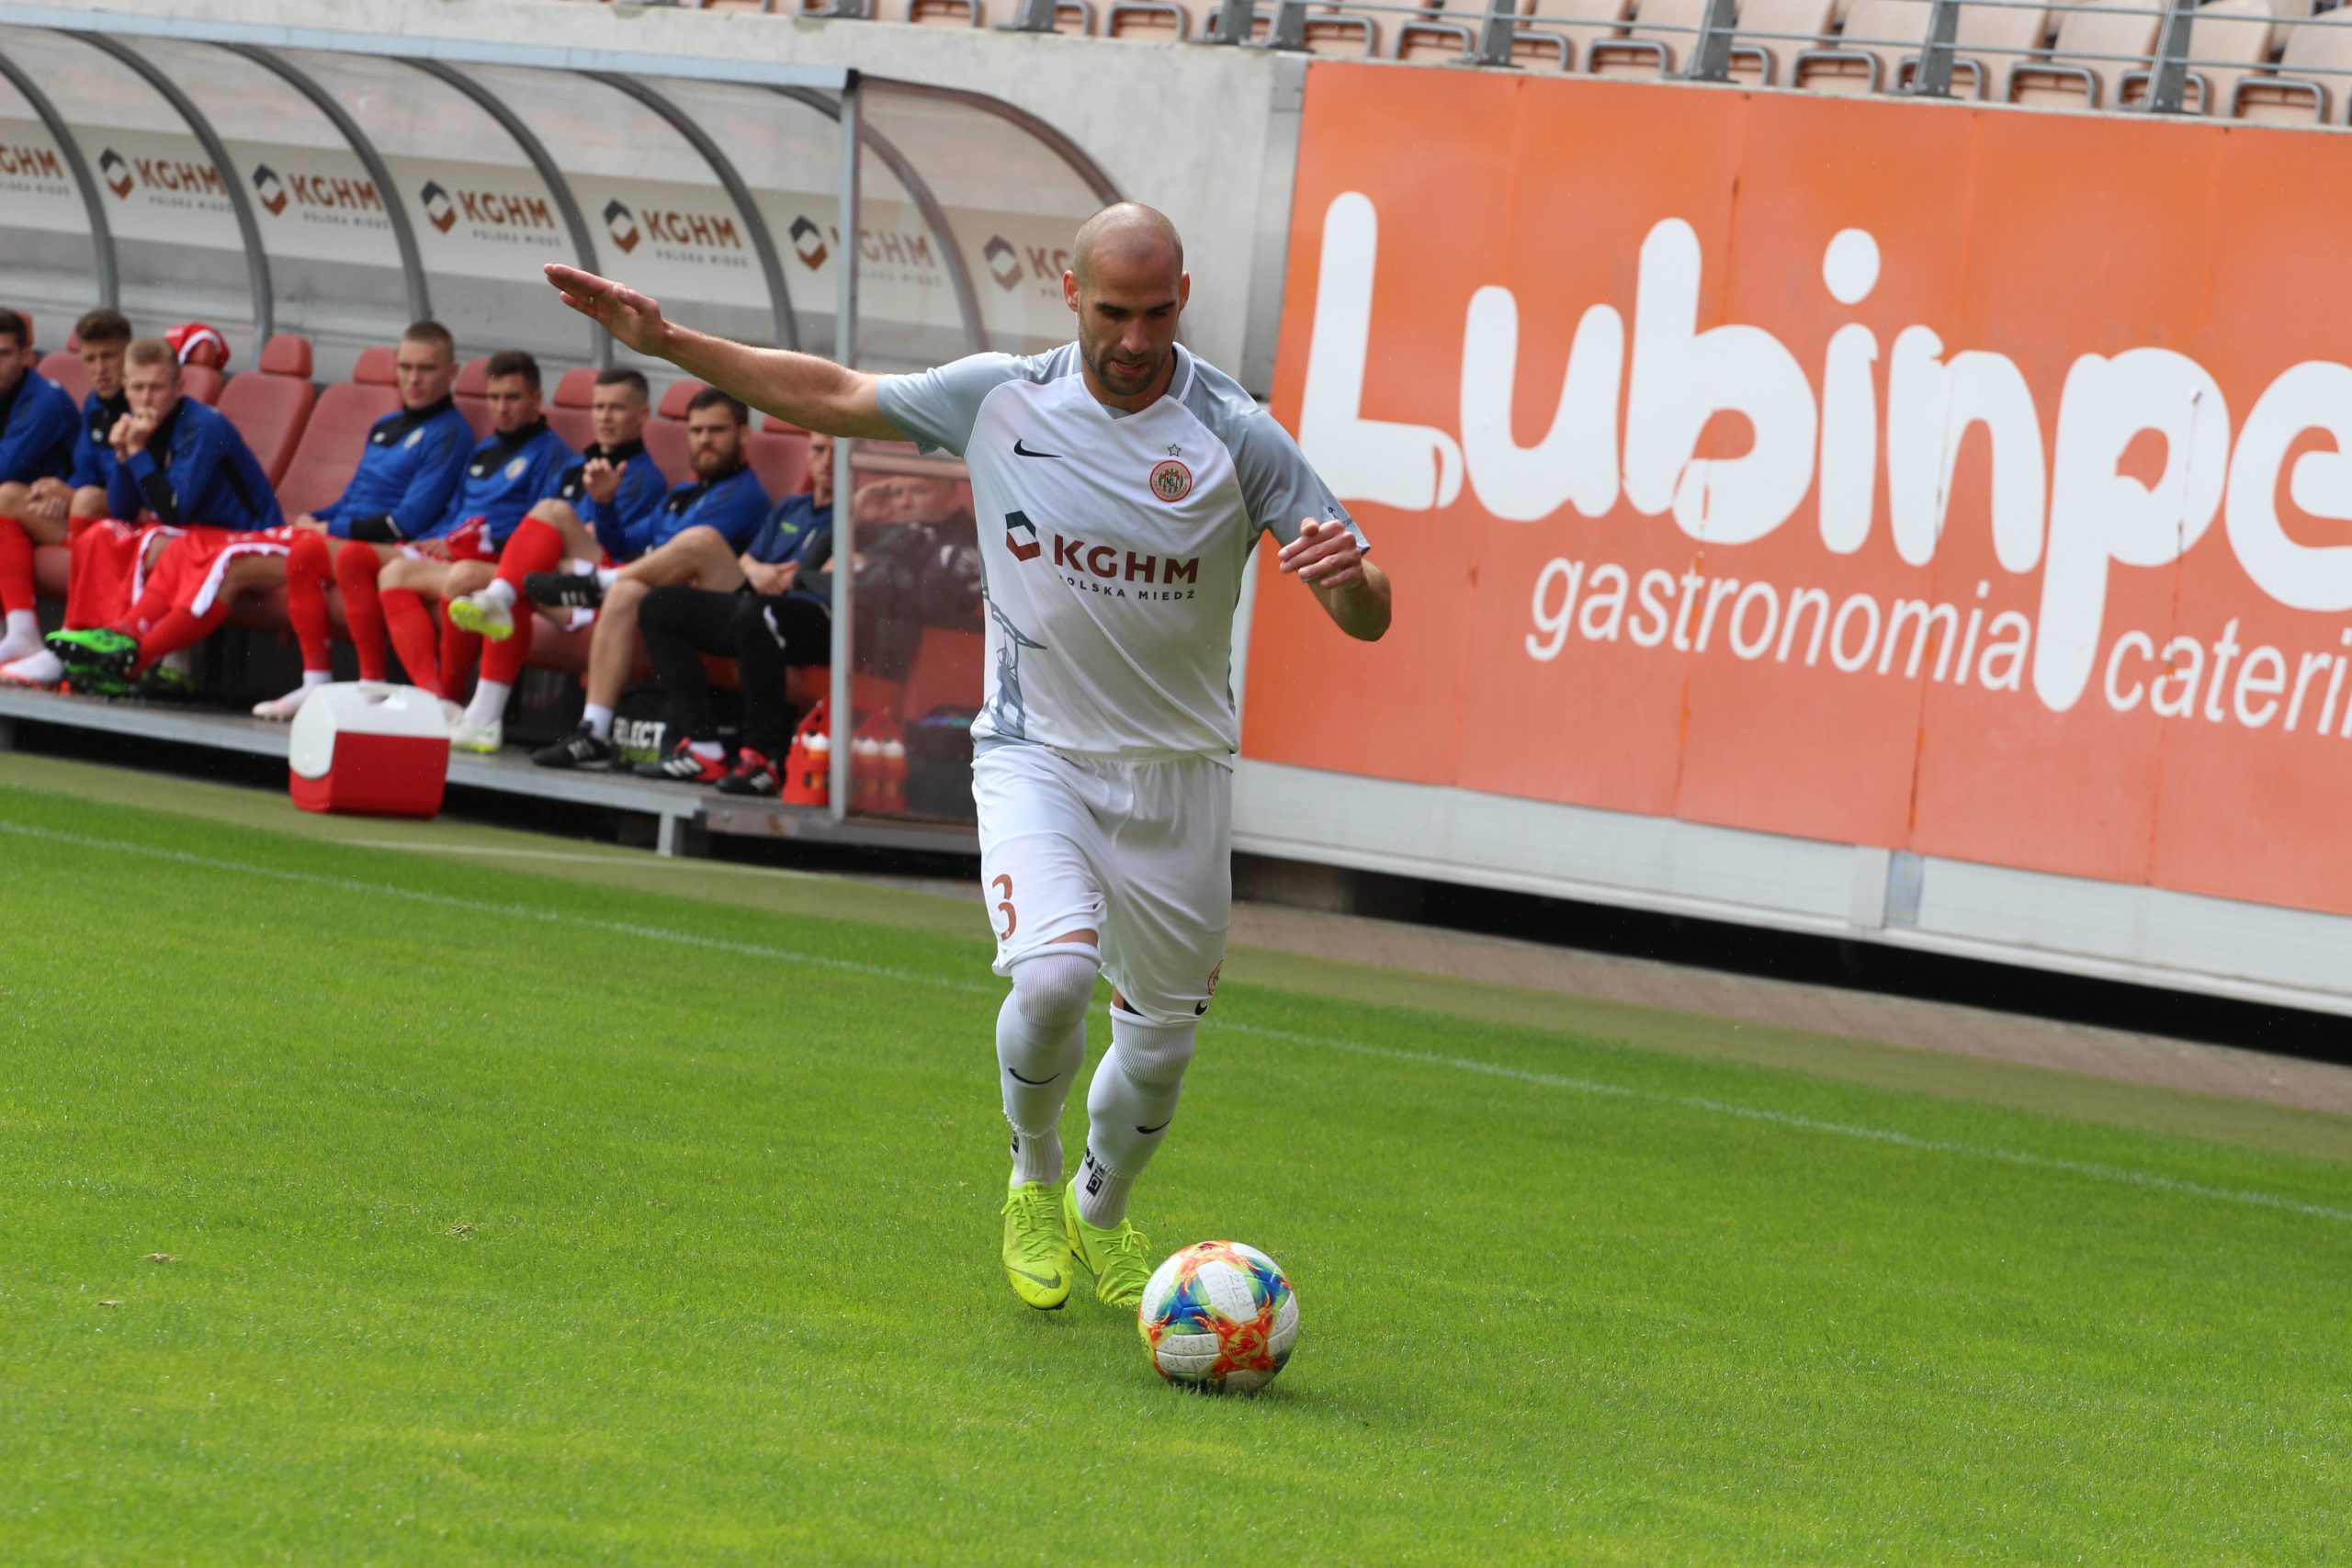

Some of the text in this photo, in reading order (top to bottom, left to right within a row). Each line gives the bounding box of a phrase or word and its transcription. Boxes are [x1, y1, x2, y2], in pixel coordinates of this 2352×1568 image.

[132, 157, 227, 196] KGHM
[288, 174, 383, 212] KGHM
[458, 190, 555, 231] KGHM
[641, 209, 741, 249] KGHM
[830, 227, 935, 267] GHM
[1055, 534, 1199, 584] KGHM
[1059, 574, 1125, 597] OLSKA
[1525, 557, 2031, 692] gastronomia
[992, 874, 1017, 942] 3
